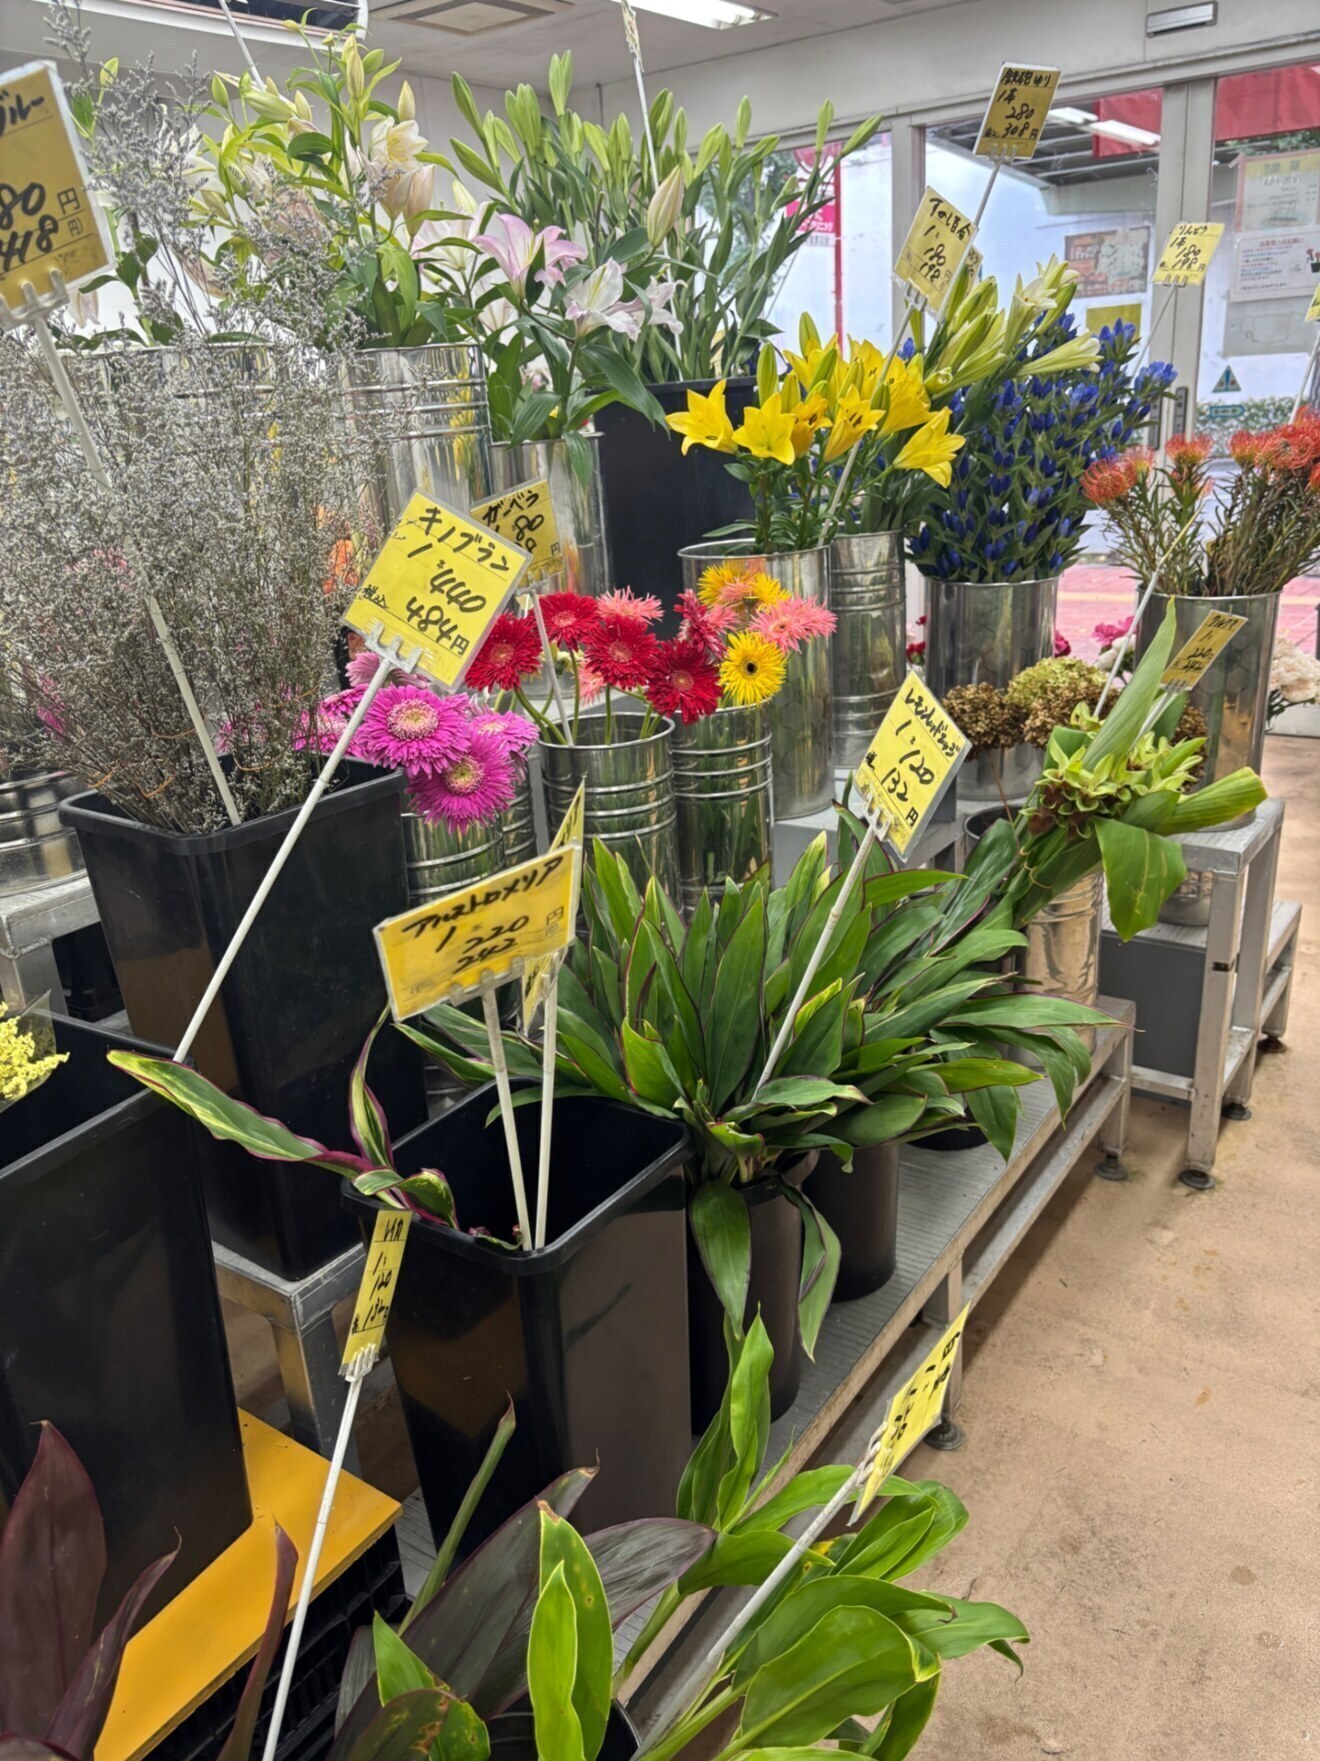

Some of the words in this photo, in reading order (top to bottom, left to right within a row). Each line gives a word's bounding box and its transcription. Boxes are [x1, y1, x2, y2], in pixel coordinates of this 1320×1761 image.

[1004, 103, 1035, 121] 280
[923, 243, 946, 267] 180
[1175, 244, 1202, 258] 180
[482, 490, 539, 527] ガーベラ
[419, 506, 510, 572] キノブラン
[430, 568, 487, 614] 440
[899, 748, 935, 785] 120
[402, 855, 564, 939] アルストロメリア
[463, 916, 530, 955] 220
